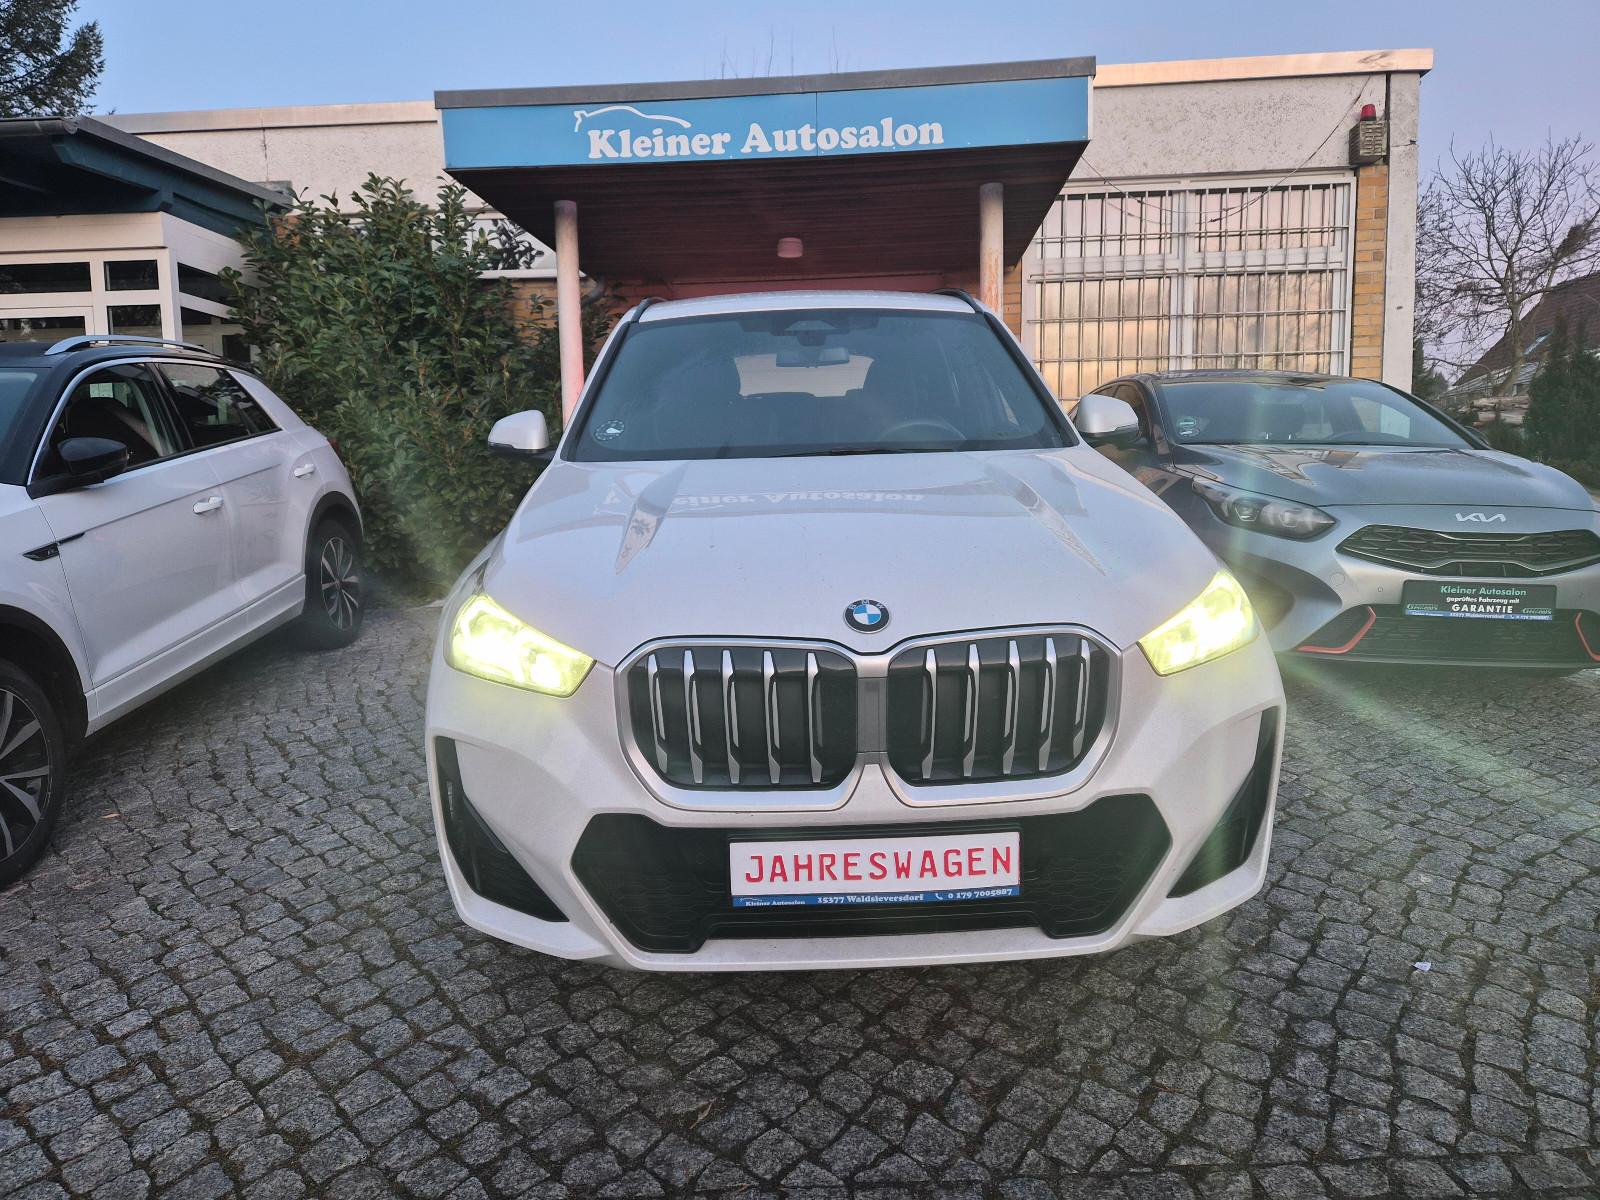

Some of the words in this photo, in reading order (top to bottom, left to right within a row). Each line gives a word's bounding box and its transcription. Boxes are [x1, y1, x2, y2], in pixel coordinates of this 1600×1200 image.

[588, 129, 731, 158] Kleiner
[741, 117, 944, 153] Autosalon
[1440, 586, 1476, 594] Kleiner
[1479, 587, 1527, 596] Autosalon
[1479, 597, 1507, 605] Fahrzeug
[1451, 604, 1513, 613] GARANTIE
[745, 846, 1011, 883] JAHRESWAGEN
[817, 896, 844, 904] 15377
